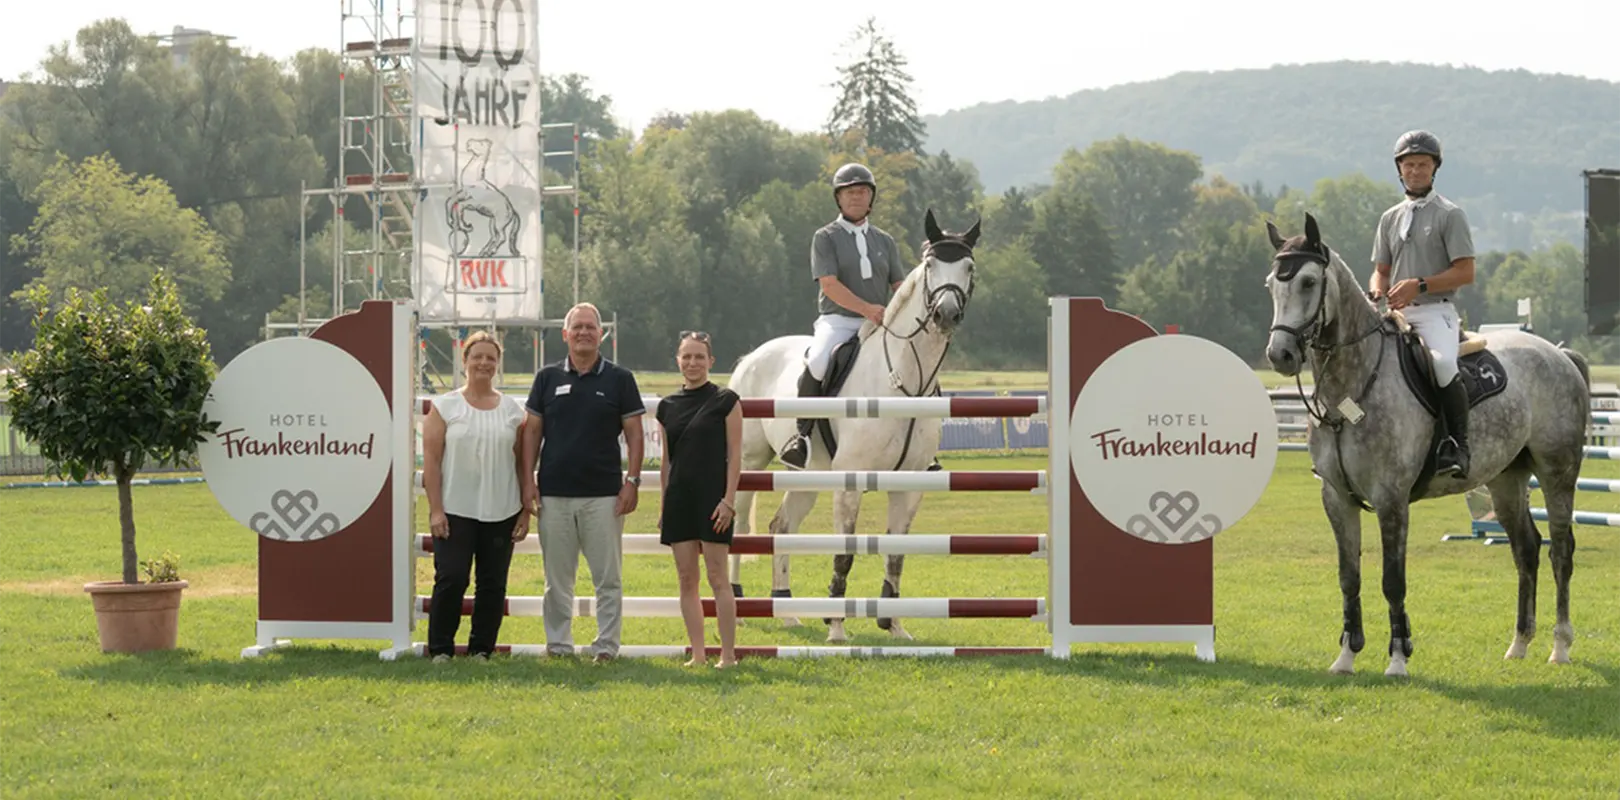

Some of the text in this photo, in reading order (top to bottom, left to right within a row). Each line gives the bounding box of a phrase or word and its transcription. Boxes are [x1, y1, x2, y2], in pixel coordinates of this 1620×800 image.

[460, 259, 508, 289] RVK
[269, 413, 328, 427] HOTEL
[1147, 413, 1209, 427] HOTEL
[216, 427, 374, 459] Frankenland
[1090, 428, 1258, 460] Frankenland
